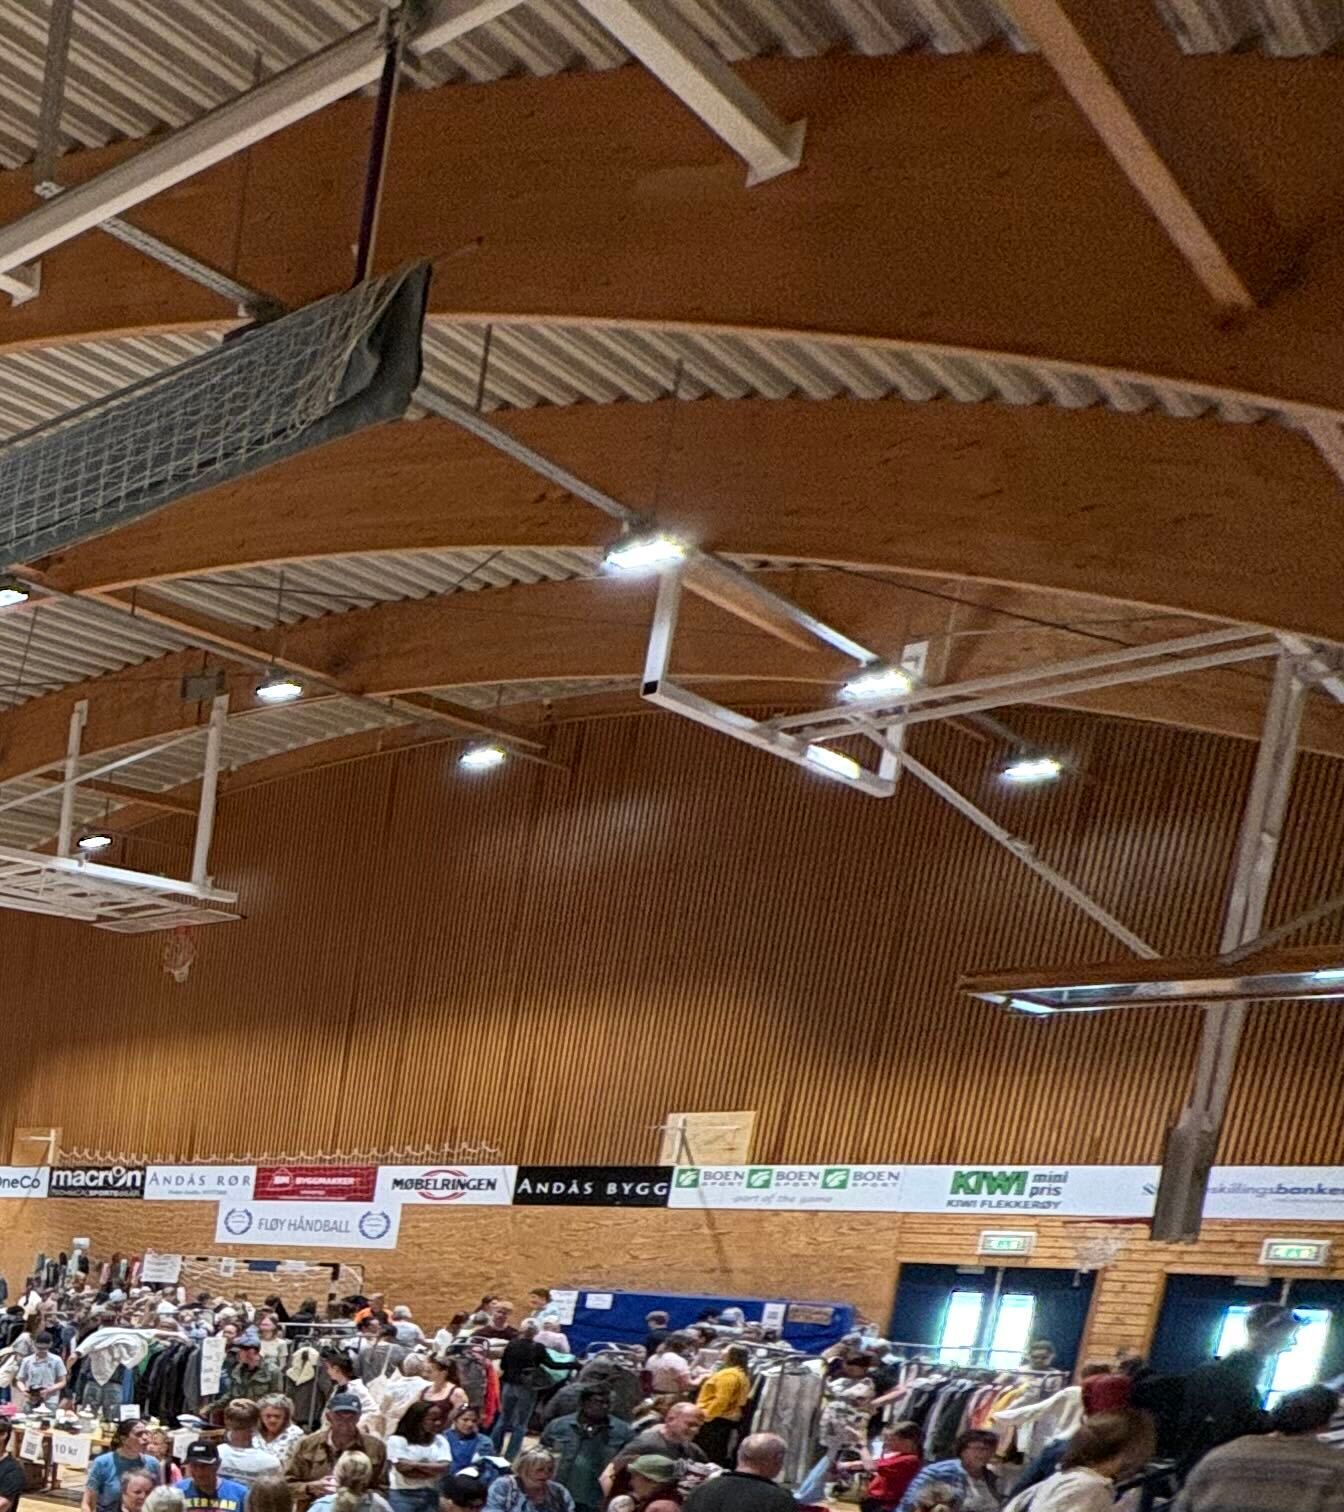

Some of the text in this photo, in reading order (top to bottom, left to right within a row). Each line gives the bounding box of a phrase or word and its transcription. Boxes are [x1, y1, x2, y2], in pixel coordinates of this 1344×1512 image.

[51, 1166, 143, 1187] macron
[149, 1172, 251, 1187] ANDÅS RØR
[703, 1171, 745, 1181] BOEN
[776, 1171, 820, 1181] BOEN
[853, 1171, 901, 1181] BOEN
[1032, 1171, 1068, 1183] mini
[391, 1178, 497, 1191] MØBELRINGEN
[517, 1178, 669, 1195] ANDÅS BYGG
[950, 1171, 1030, 1195] KIWI
[1029, 1185, 1062, 1198] pris
[1206, 1183, 1344, 1197] skillingsbanke
[760, 1192, 776, 1203] of
[778, 1194, 796, 1203] the
[799, 1196, 832, 1204] game
[946, 1199, 1062, 1210] KIWI FLEKKERØY
[258, 1216, 351, 1233] FLØY HÅNDBALL
[55, 1444, 79, 1456] 10 kr
